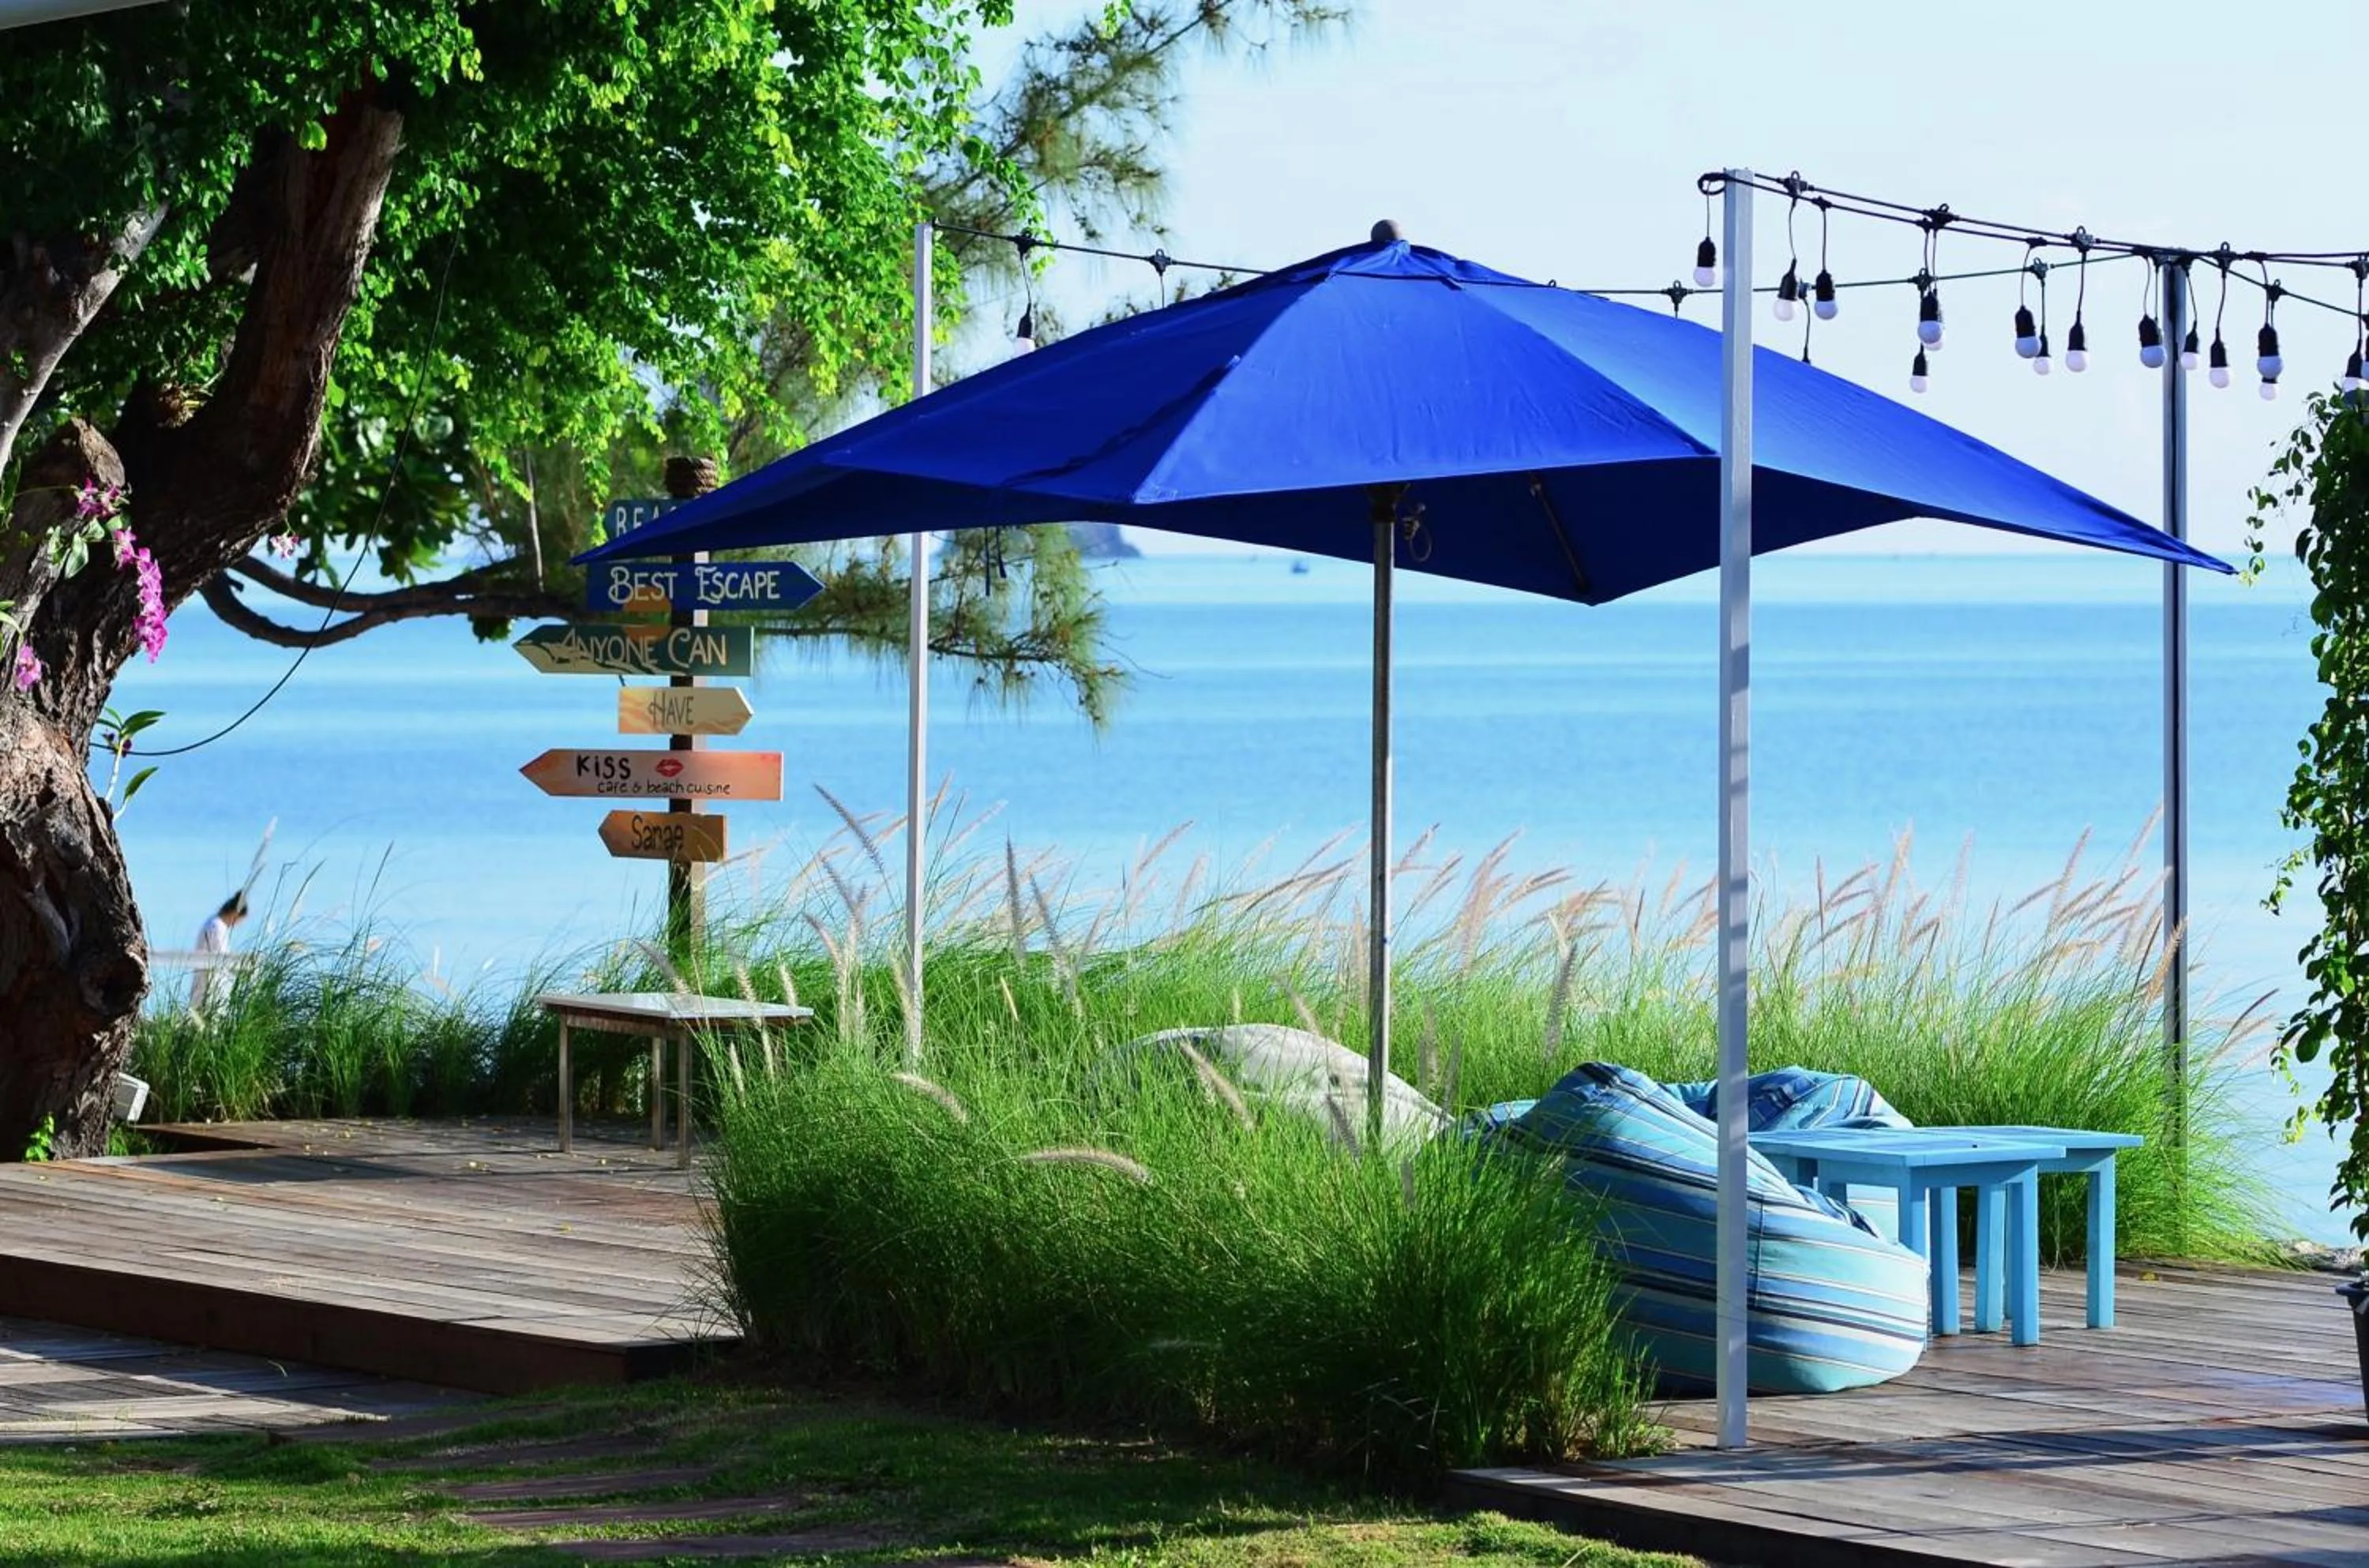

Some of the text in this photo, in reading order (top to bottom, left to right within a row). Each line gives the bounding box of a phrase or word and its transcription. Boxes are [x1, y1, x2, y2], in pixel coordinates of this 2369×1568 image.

[608, 566, 780, 604] BEST ESCAPE
[561, 628, 726, 669] ANYONE CAN
[648, 692, 694, 727] HAVE
[647, 778, 684, 794] beach
[686, 782, 730, 795] cuisine
